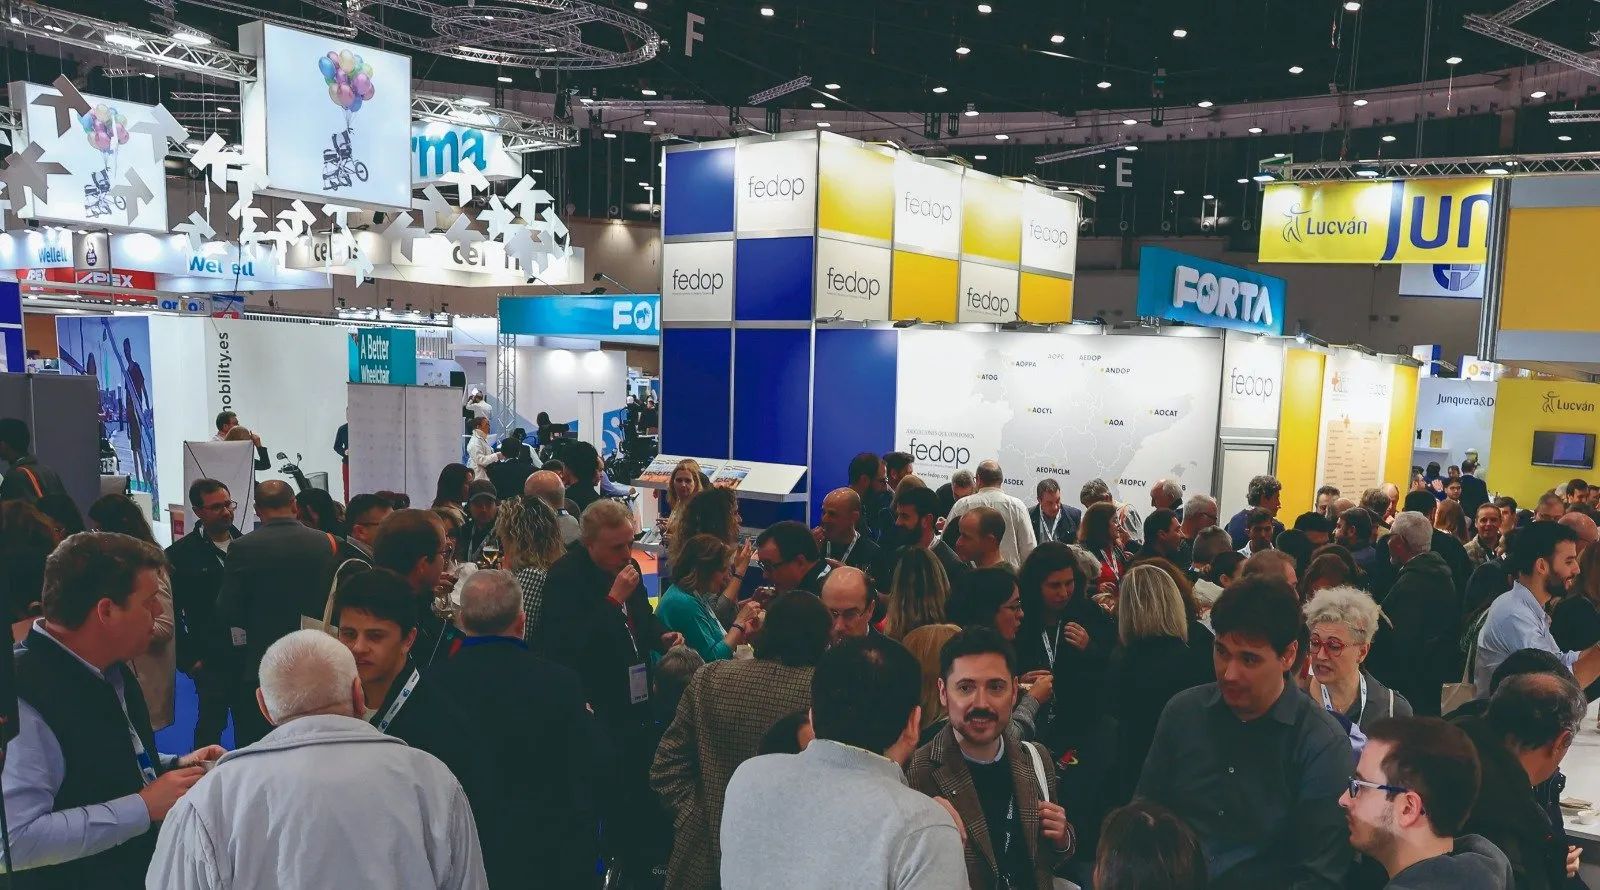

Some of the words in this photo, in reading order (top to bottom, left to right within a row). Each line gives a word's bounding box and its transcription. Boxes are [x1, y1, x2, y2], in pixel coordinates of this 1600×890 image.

[684, 12, 706, 57] F
[1116, 157, 1134, 188] E
[748, 174, 805, 202] fedop
[904, 191, 953, 225] fedop
[1306, 216, 1368, 235] Lucván
[38, 247, 68, 264] Wellell
[189, 256, 255, 277] Welell
[672, 268, 724, 295] fedop
[826, 267, 881, 301] fedop
[1173, 265, 1273, 325] FORTA
[966, 287, 1010, 317] fedop
[361, 334, 367, 359] A
[367, 333, 389, 360] Better
[1108, 419, 1124, 427] AOA
[1154, 408, 1178, 417] AOCAT
[909, 438, 970, 469] fedop
